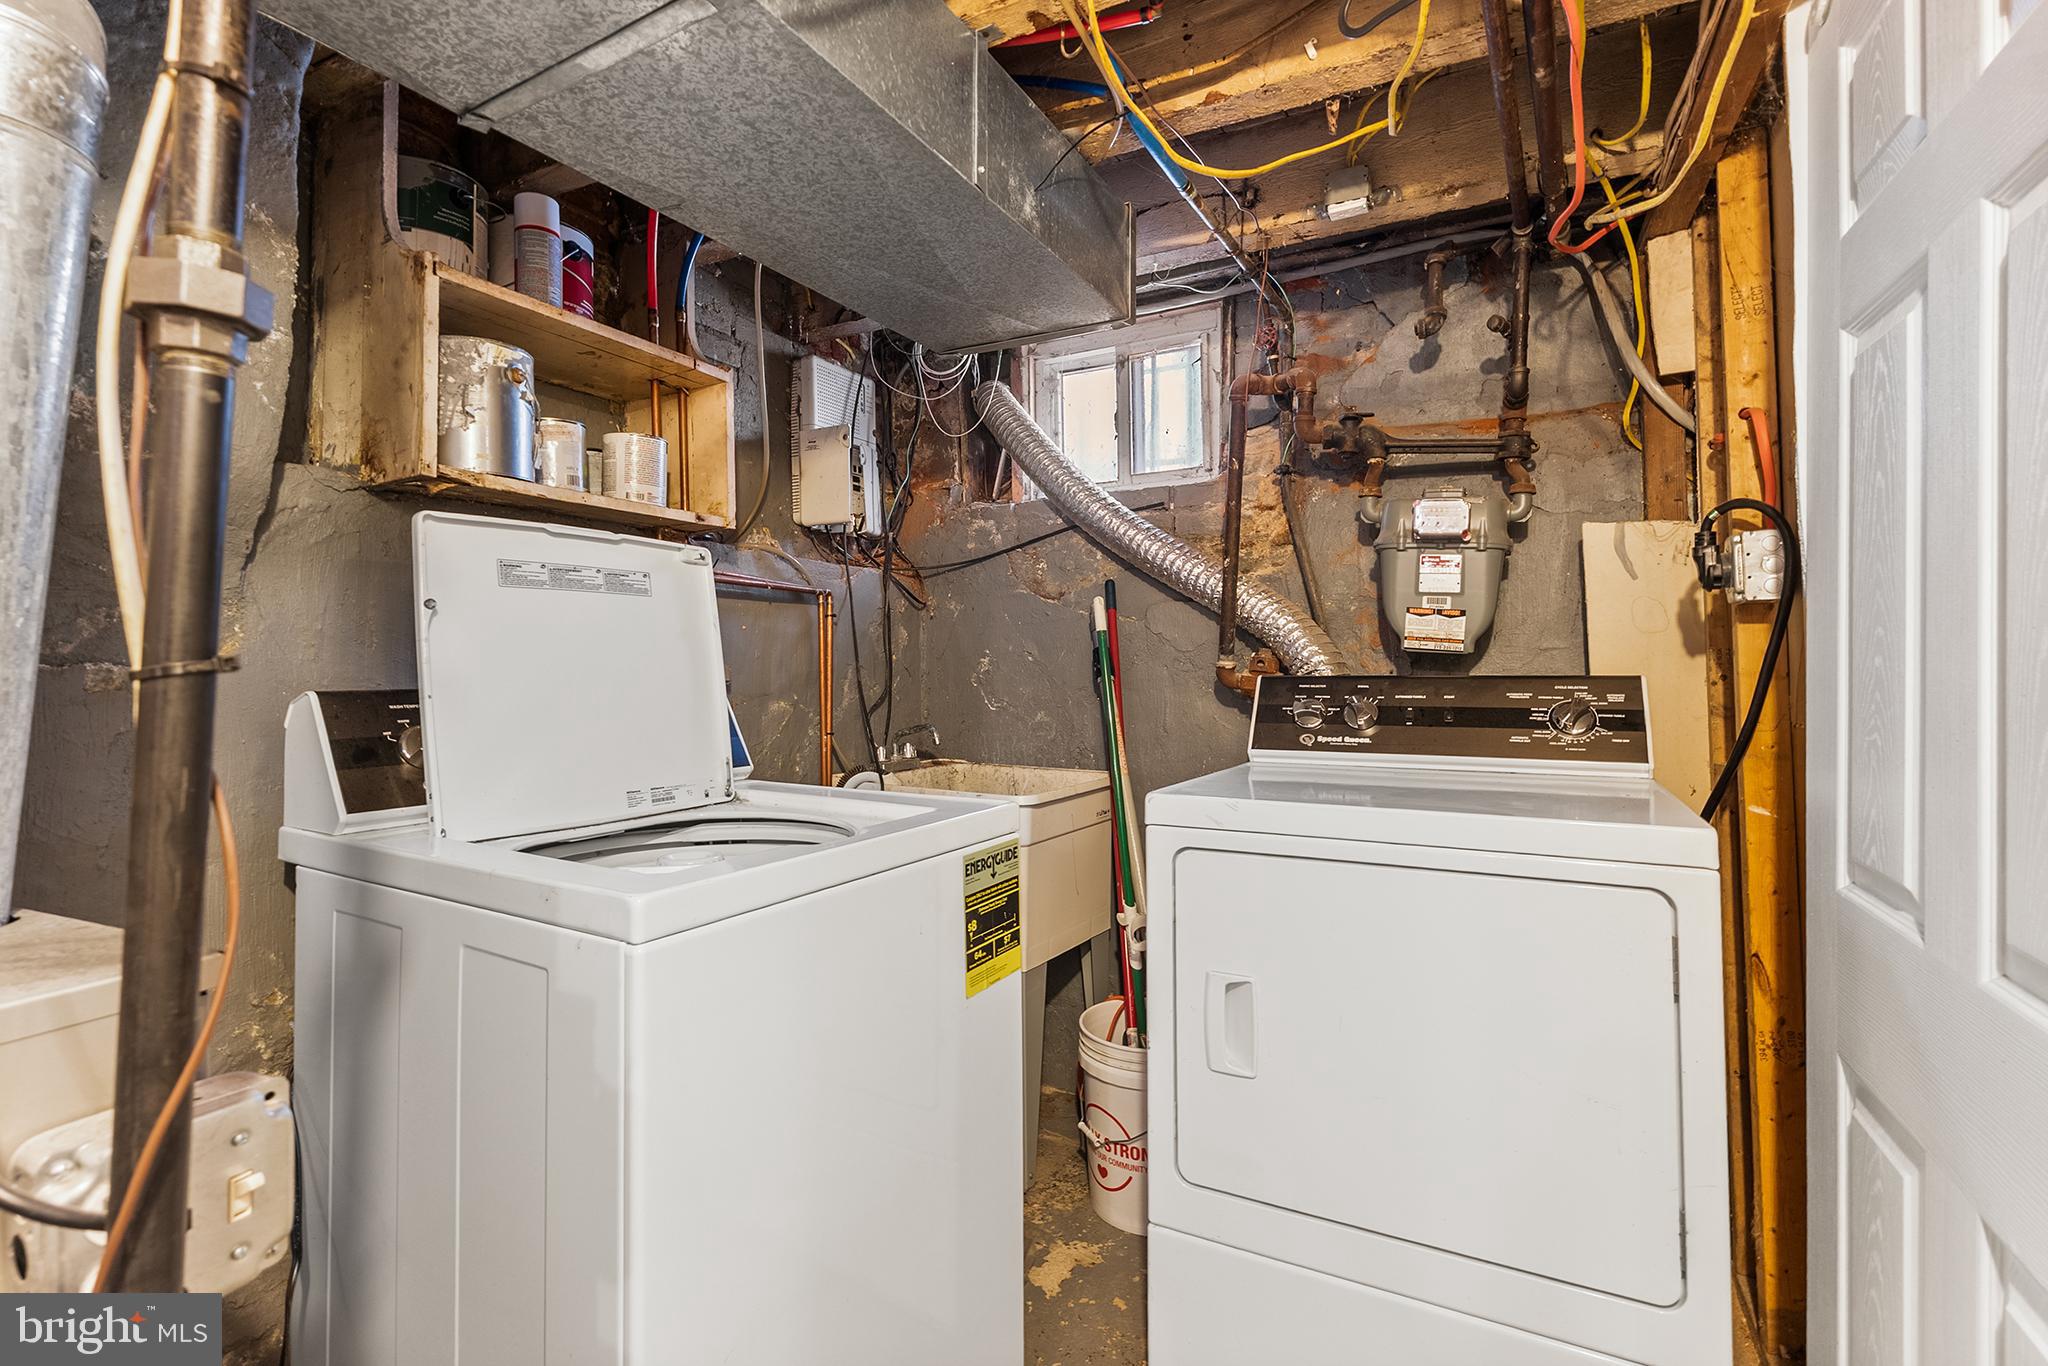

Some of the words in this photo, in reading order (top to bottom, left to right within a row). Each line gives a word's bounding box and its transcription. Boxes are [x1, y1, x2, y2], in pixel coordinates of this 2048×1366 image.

[1731, 289, 1746, 321] SELECT
[1751, 285, 1766, 316] SELECT
[1317, 735, 1343, 743] Speed
[965, 846, 1018, 878] ENERGYGUIDE
